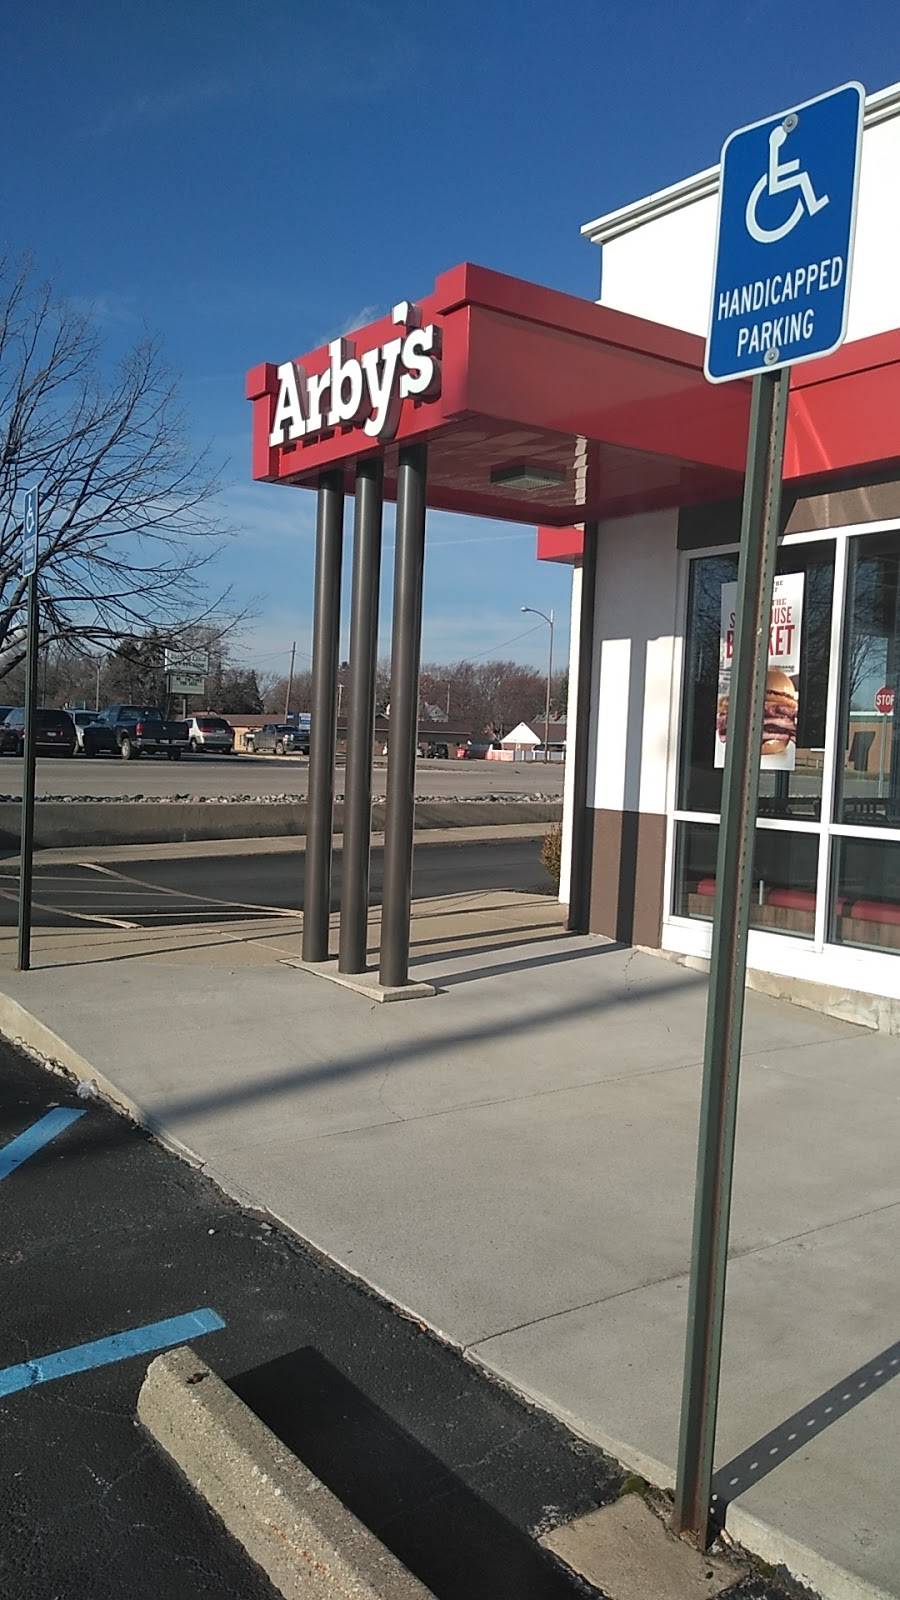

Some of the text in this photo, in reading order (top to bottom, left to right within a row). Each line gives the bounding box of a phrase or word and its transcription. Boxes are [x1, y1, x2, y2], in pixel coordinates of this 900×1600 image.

[717, 255, 844, 321] HANDICAPPED
[736, 308, 815, 358] PARKING
[268, 300, 436, 447] Arby's
